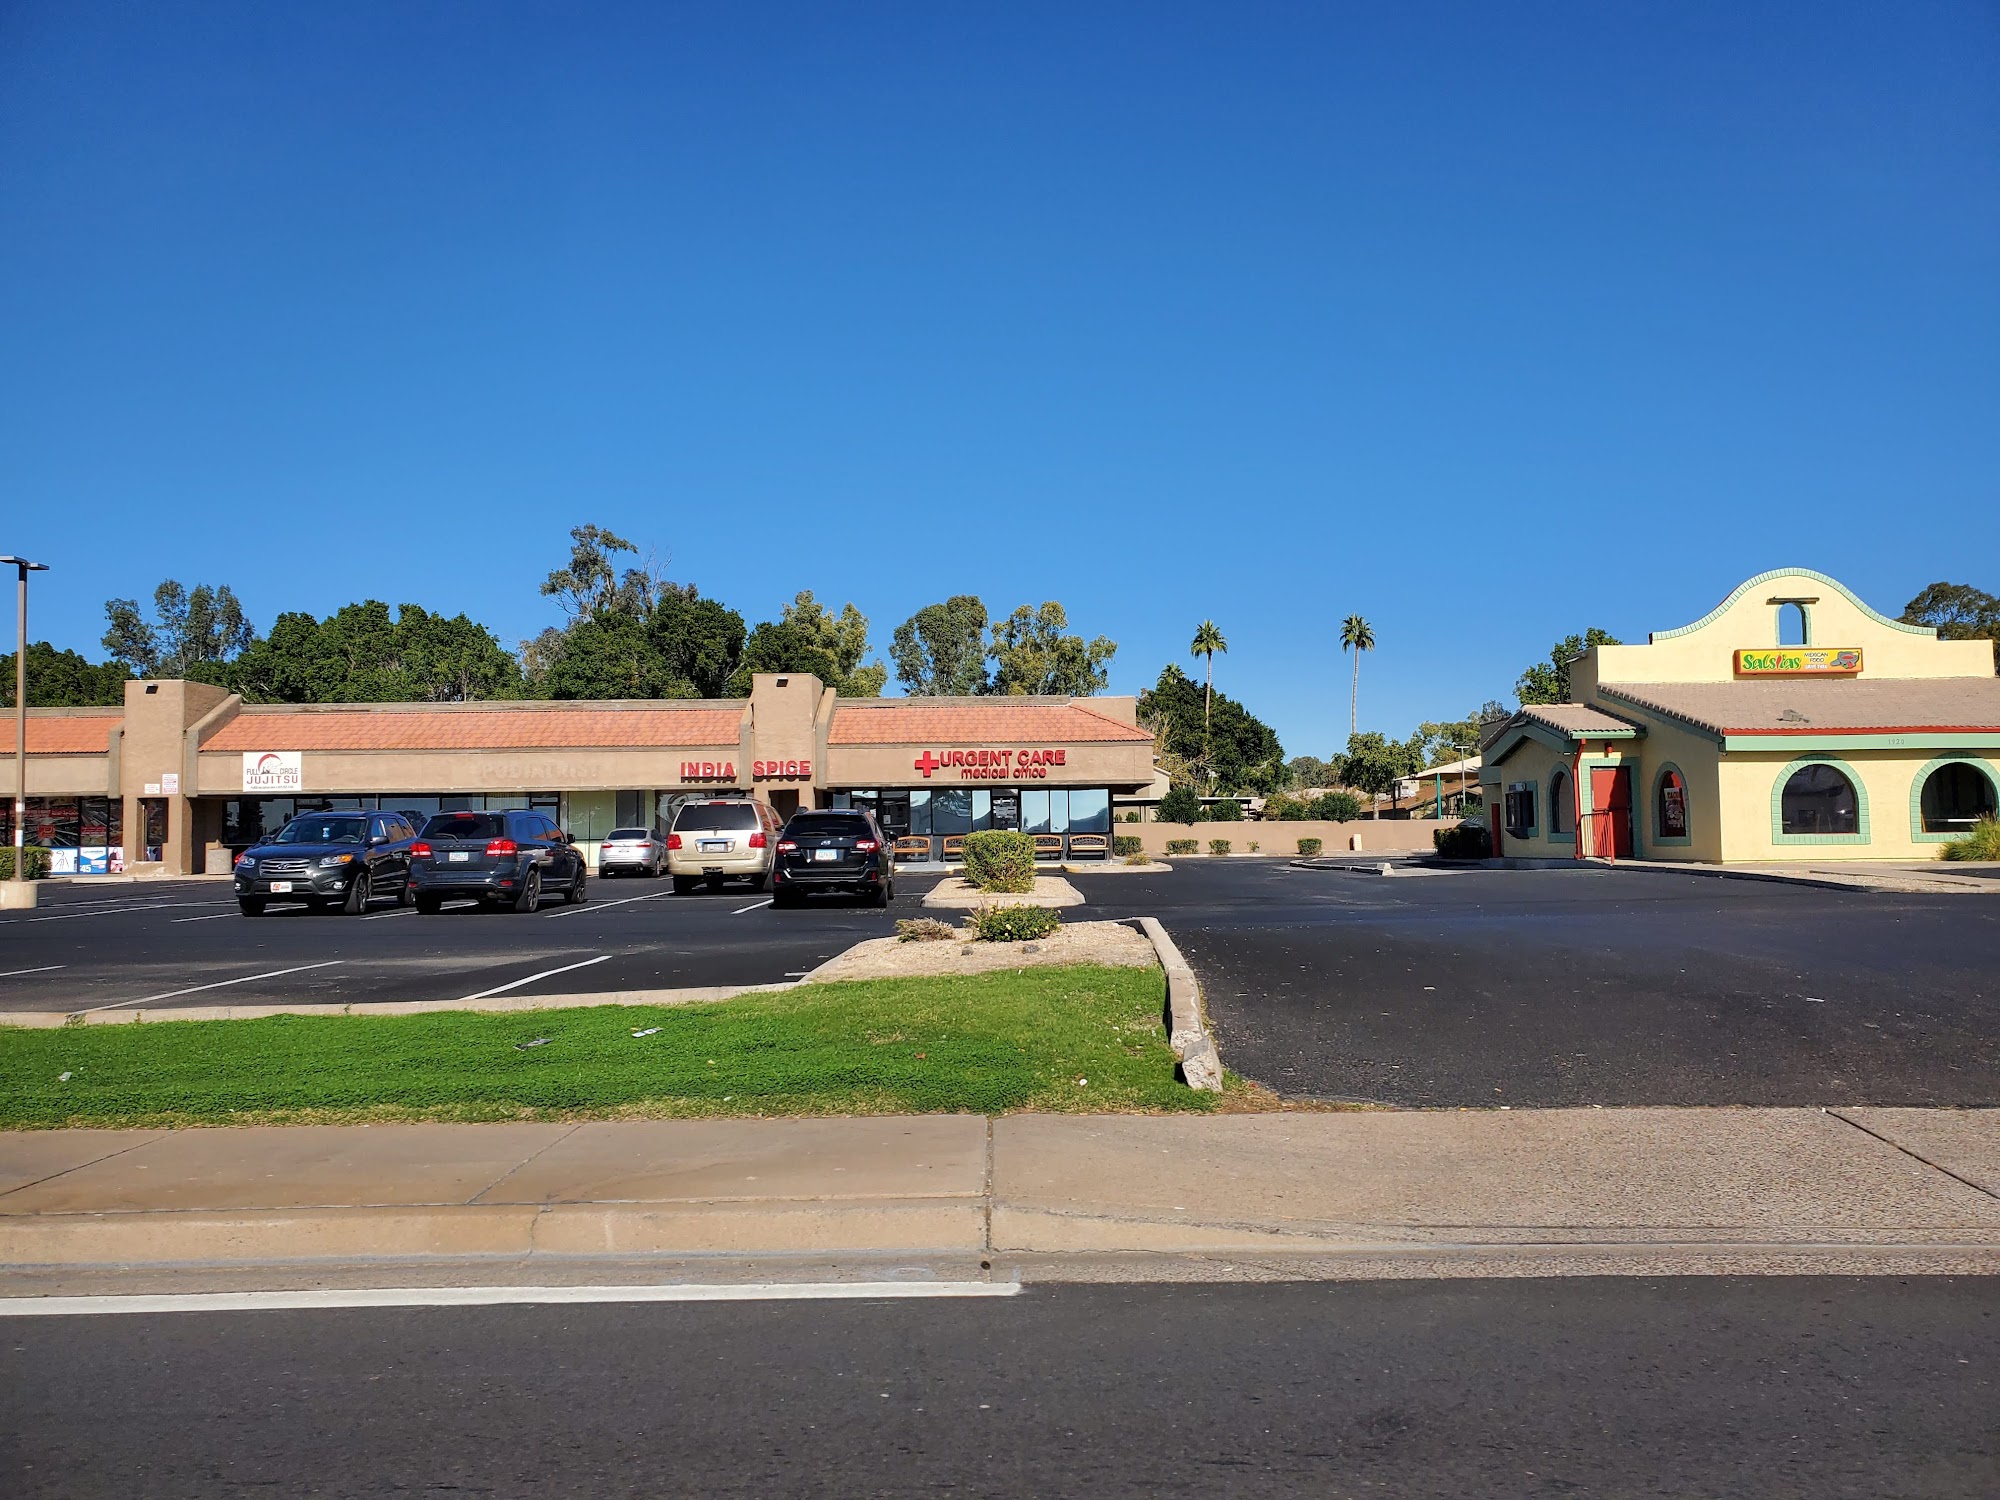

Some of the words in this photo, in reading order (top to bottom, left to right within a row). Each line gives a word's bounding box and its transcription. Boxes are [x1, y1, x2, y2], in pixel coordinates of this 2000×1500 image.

[940, 751, 1012, 766] URGENT
[1017, 750, 1066, 766] CARE
[280, 767, 298, 775] CIRCLE
[680, 762, 735, 778] INDIA
[753, 760, 811, 777] SPICE
[961, 766, 1009, 779] medical
[1013, 766, 1047, 779] office
[246, 775, 298, 784] JUJITSU
